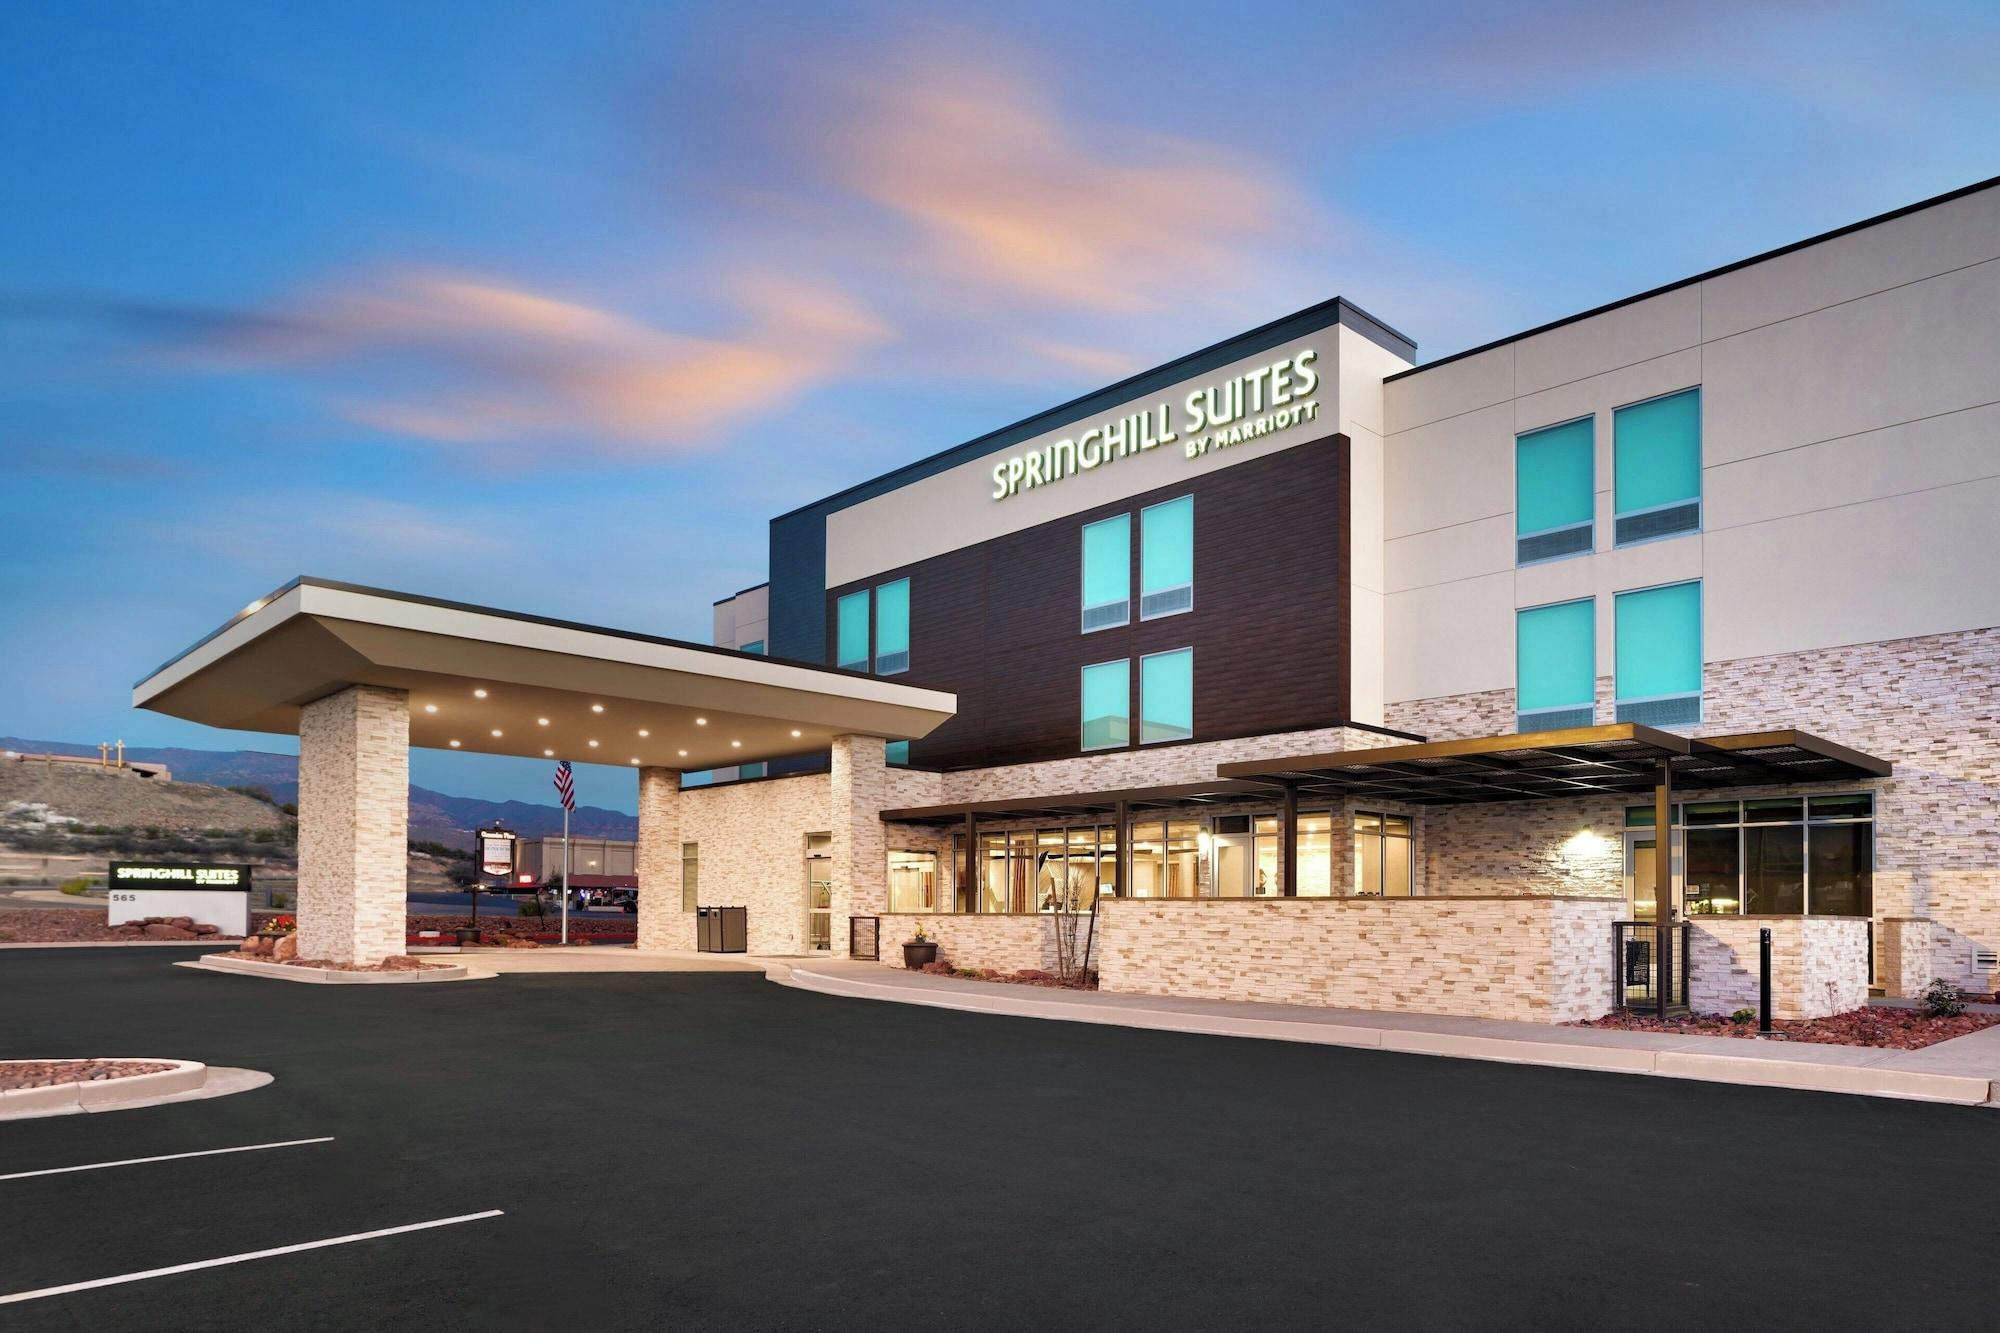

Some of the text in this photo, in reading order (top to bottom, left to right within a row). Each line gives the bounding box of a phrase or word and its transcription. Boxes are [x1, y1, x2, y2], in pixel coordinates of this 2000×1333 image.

[992, 350, 1319, 501] SPRINGHILL SUITES
[1185, 400, 1319, 458] BY MARRIOTT
[116, 867, 239, 880] SPRINGHILL SUITES
[113, 894, 136, 902] 565
